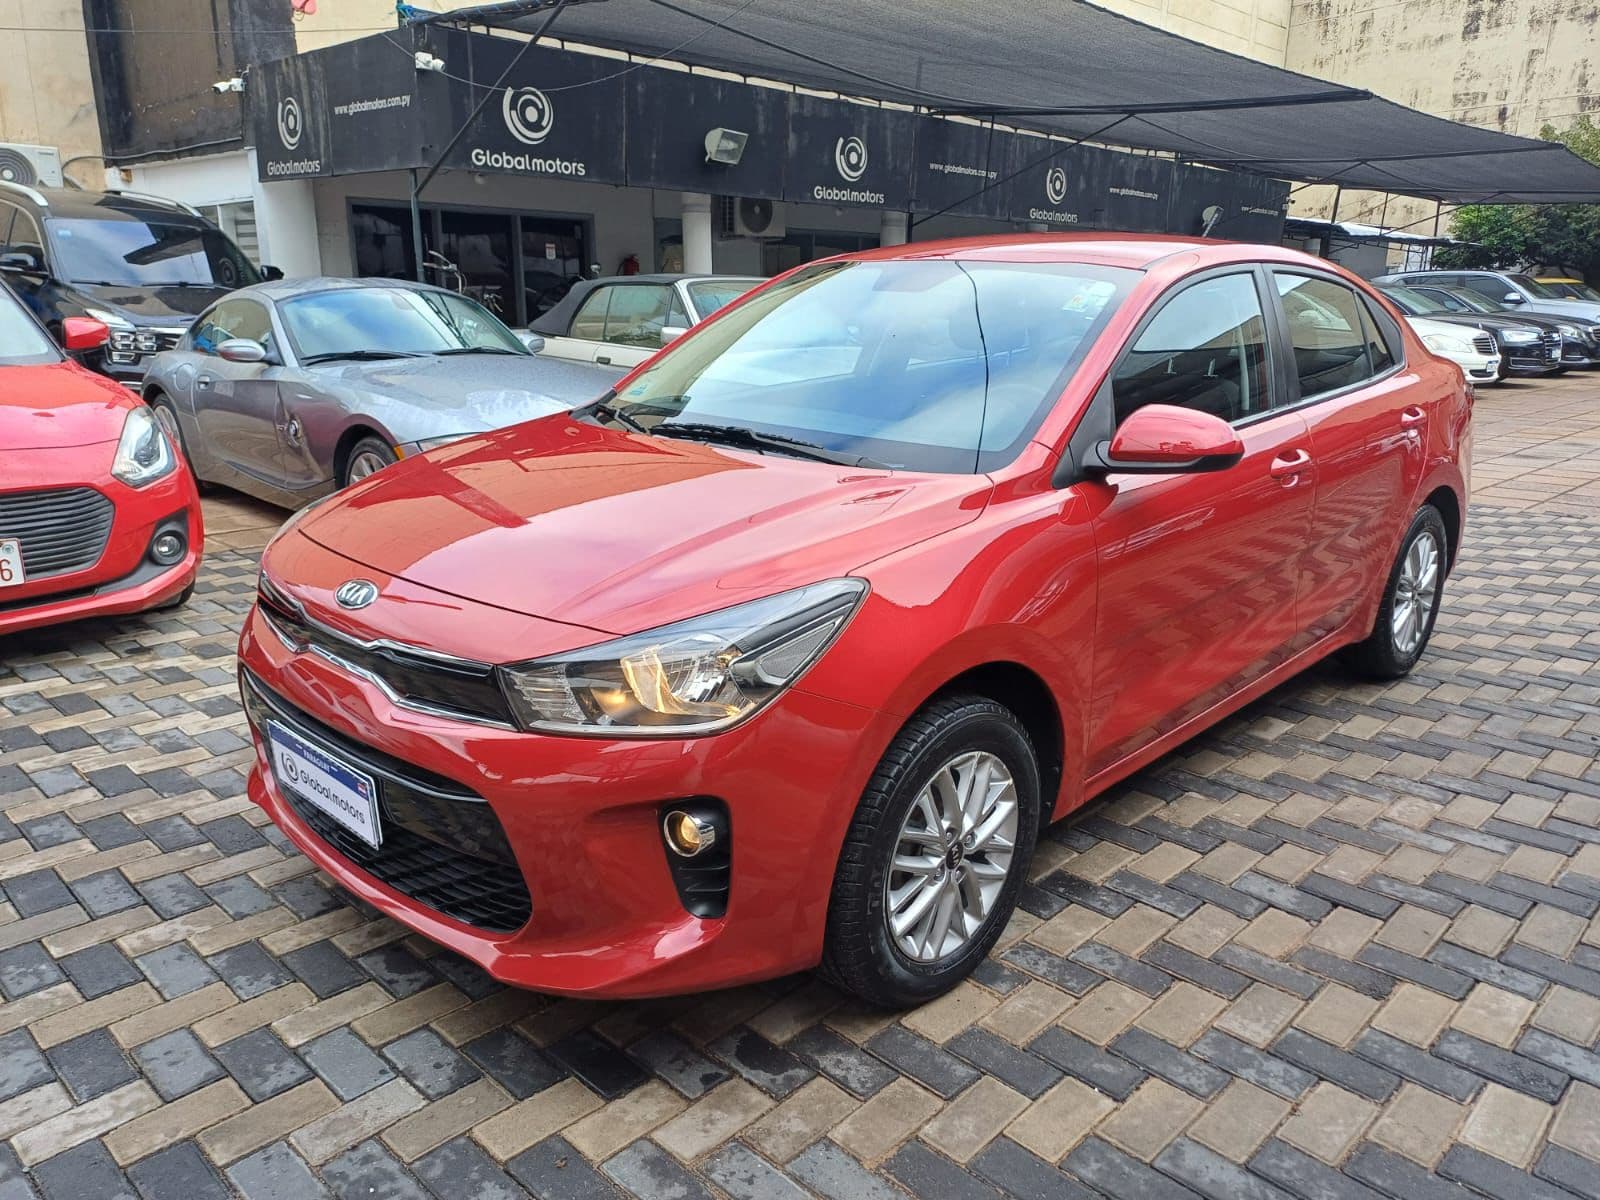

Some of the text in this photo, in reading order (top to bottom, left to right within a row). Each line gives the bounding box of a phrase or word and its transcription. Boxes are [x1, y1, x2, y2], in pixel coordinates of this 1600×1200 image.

[267, 158, 321, 176] Globalmotors
[471, 148, 586, 176] Globalmotors
[813, 185, 885, 205] Globalmotors
[1029, 207, 1079, 224] Globalmotors
[0, 559, 13, 582] 6
[337, 582, 370, 605] KIA
[300, 769, 366, 824] Globalmotors
